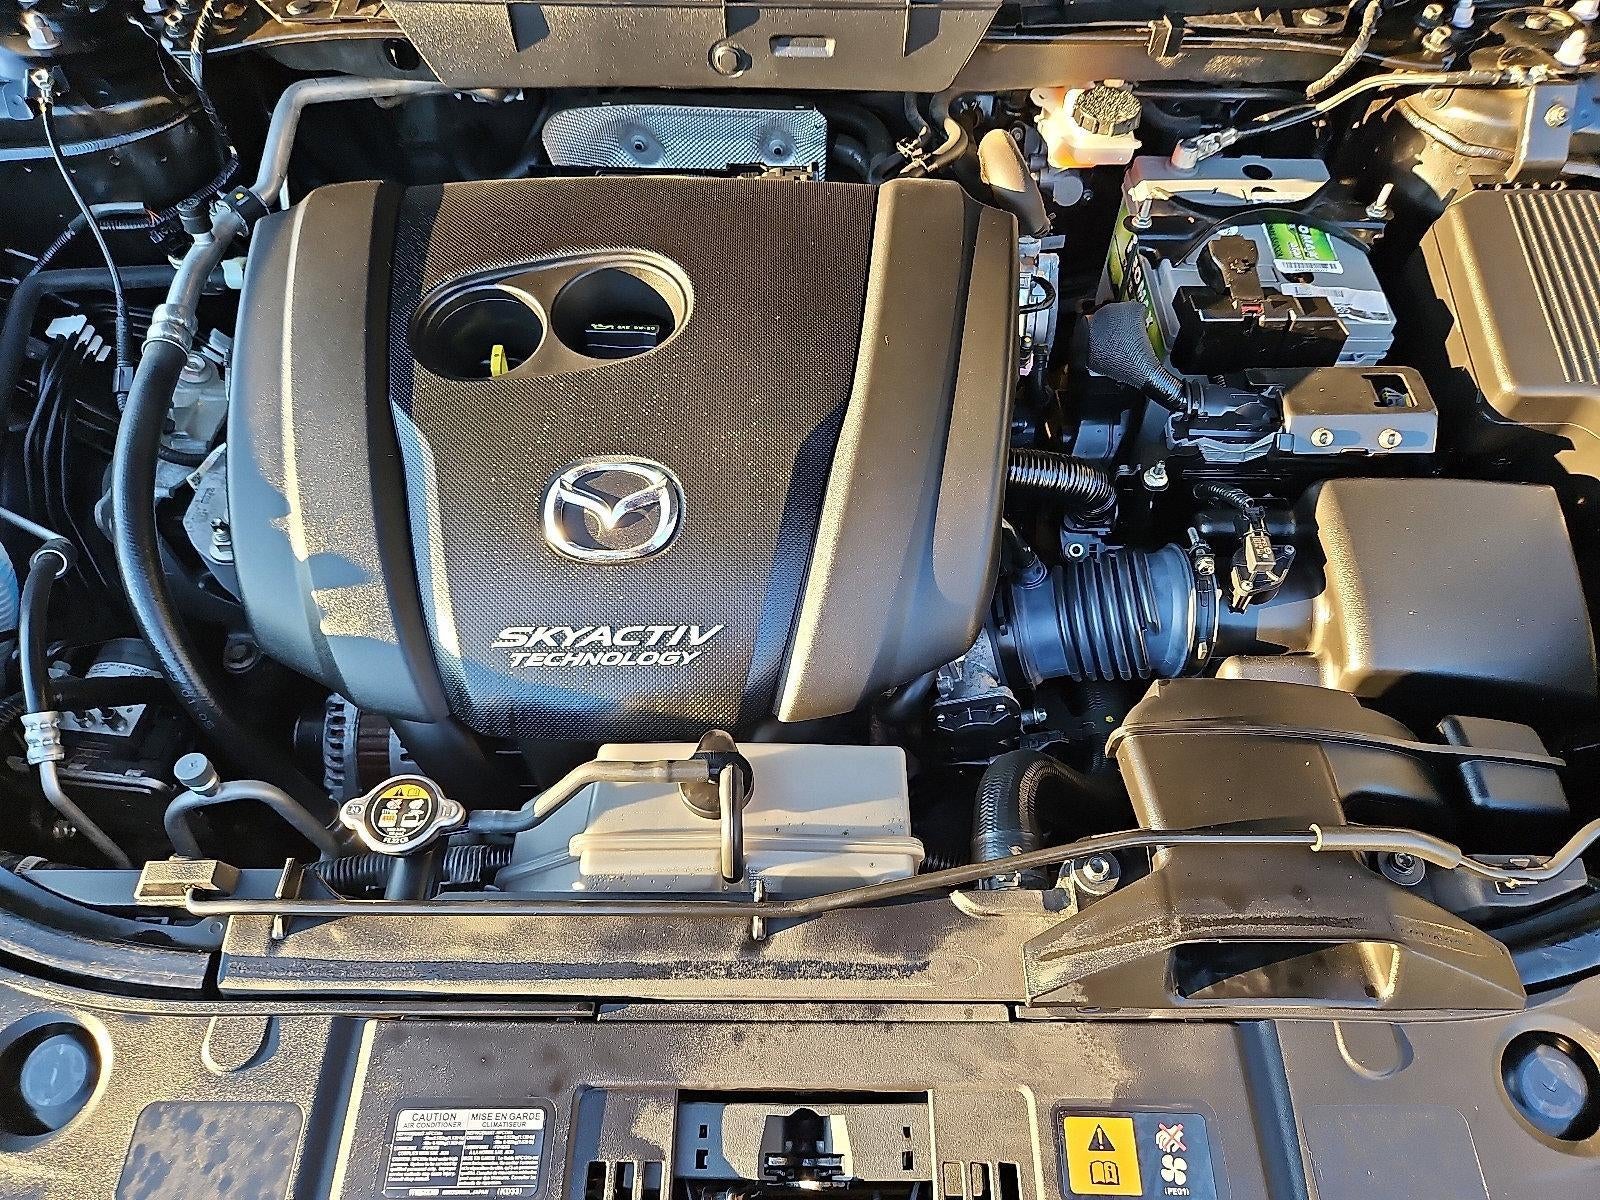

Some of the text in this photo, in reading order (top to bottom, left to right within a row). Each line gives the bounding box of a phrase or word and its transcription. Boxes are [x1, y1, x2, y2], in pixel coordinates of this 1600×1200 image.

[490, 624, 725, 648] SKYACTIV
[510, 650, 703, 668] TECHNOLOGY
[412, 1112, 457, 1122] CAUTION
[470, 1112, 541, 1121] MISE EN GARDE
[416, 1121, 462, 1129] CONDITIONER
